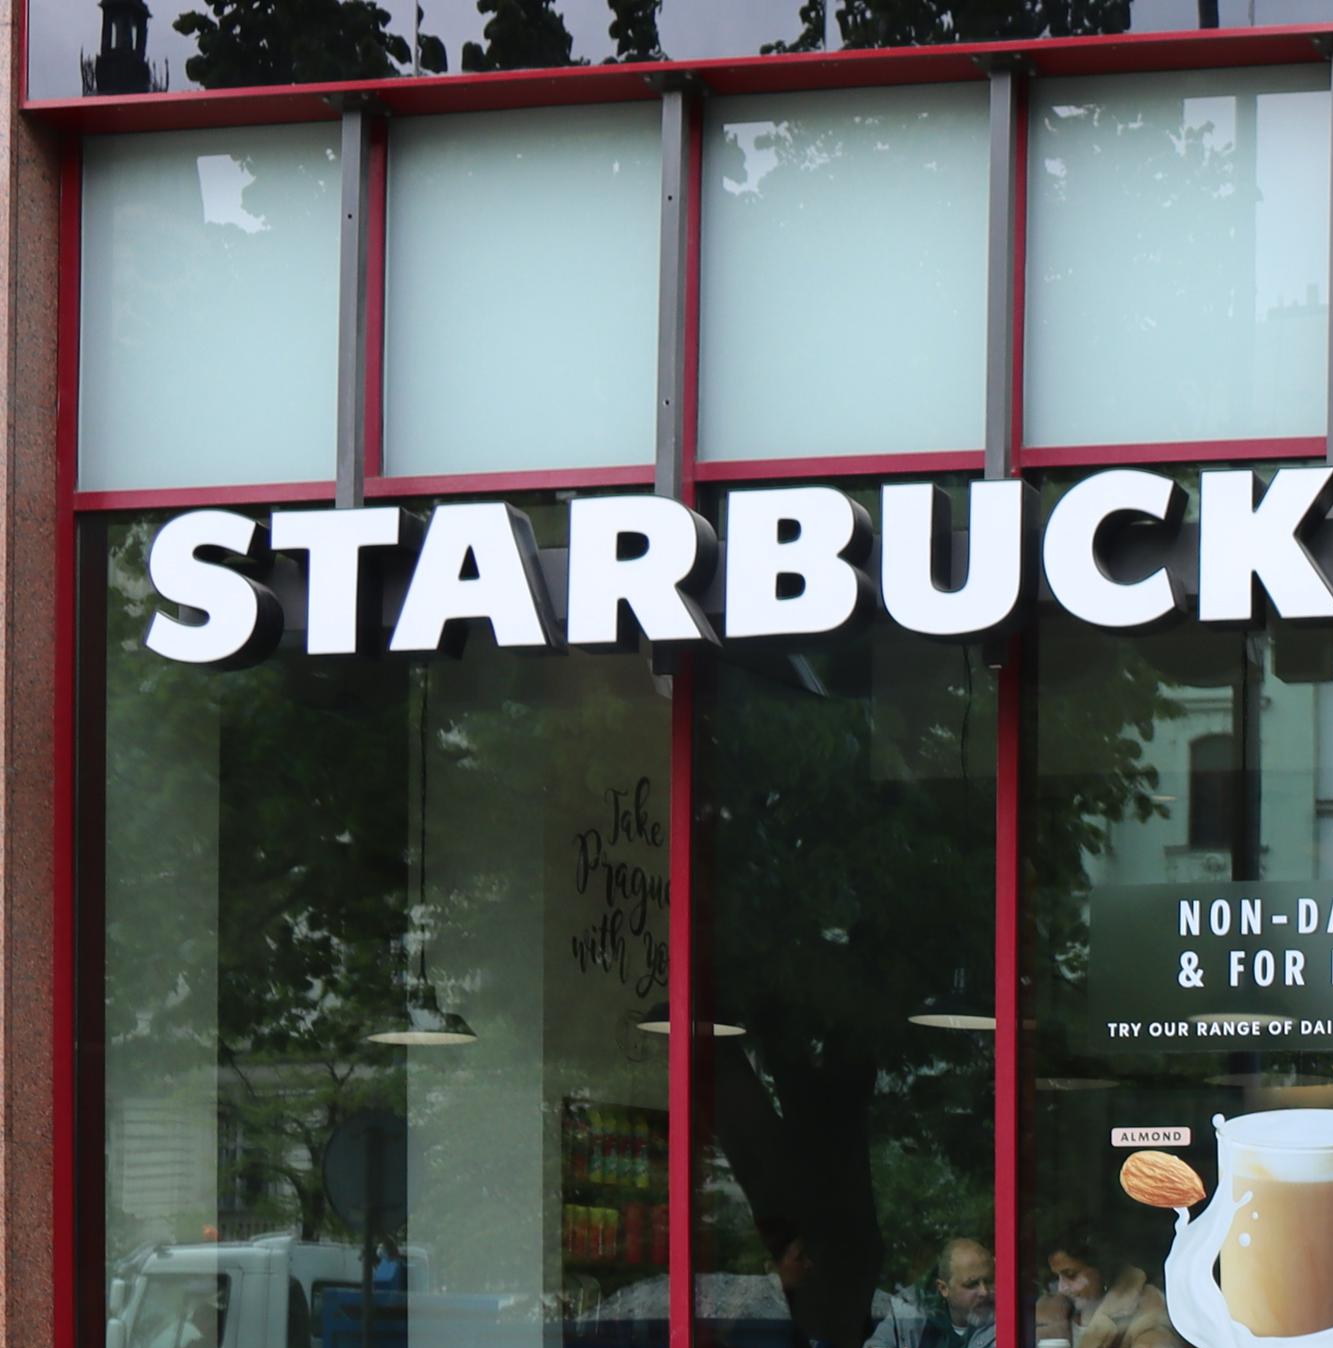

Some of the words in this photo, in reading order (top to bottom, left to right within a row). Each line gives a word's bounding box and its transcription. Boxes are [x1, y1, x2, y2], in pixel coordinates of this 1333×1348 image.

[605, 776, 664, 847] Take
[575, 829, 669, 936] Pragu
[572, 909, 627, 984] with
[635, 932, 669, 998] yo
[1178, 951, 1204, 988] &
[1229, 950, 1306, 986] FOR
[1108, 1022, 1142, 1038] TRY
[1149, 1022, 1189, 1037] OUR
[1197, 1021, 1261, 1037] RANGE
[1268, 1020, 1294, 1036] OF
[1120, 1130, 1183, 1144] ALMOND
